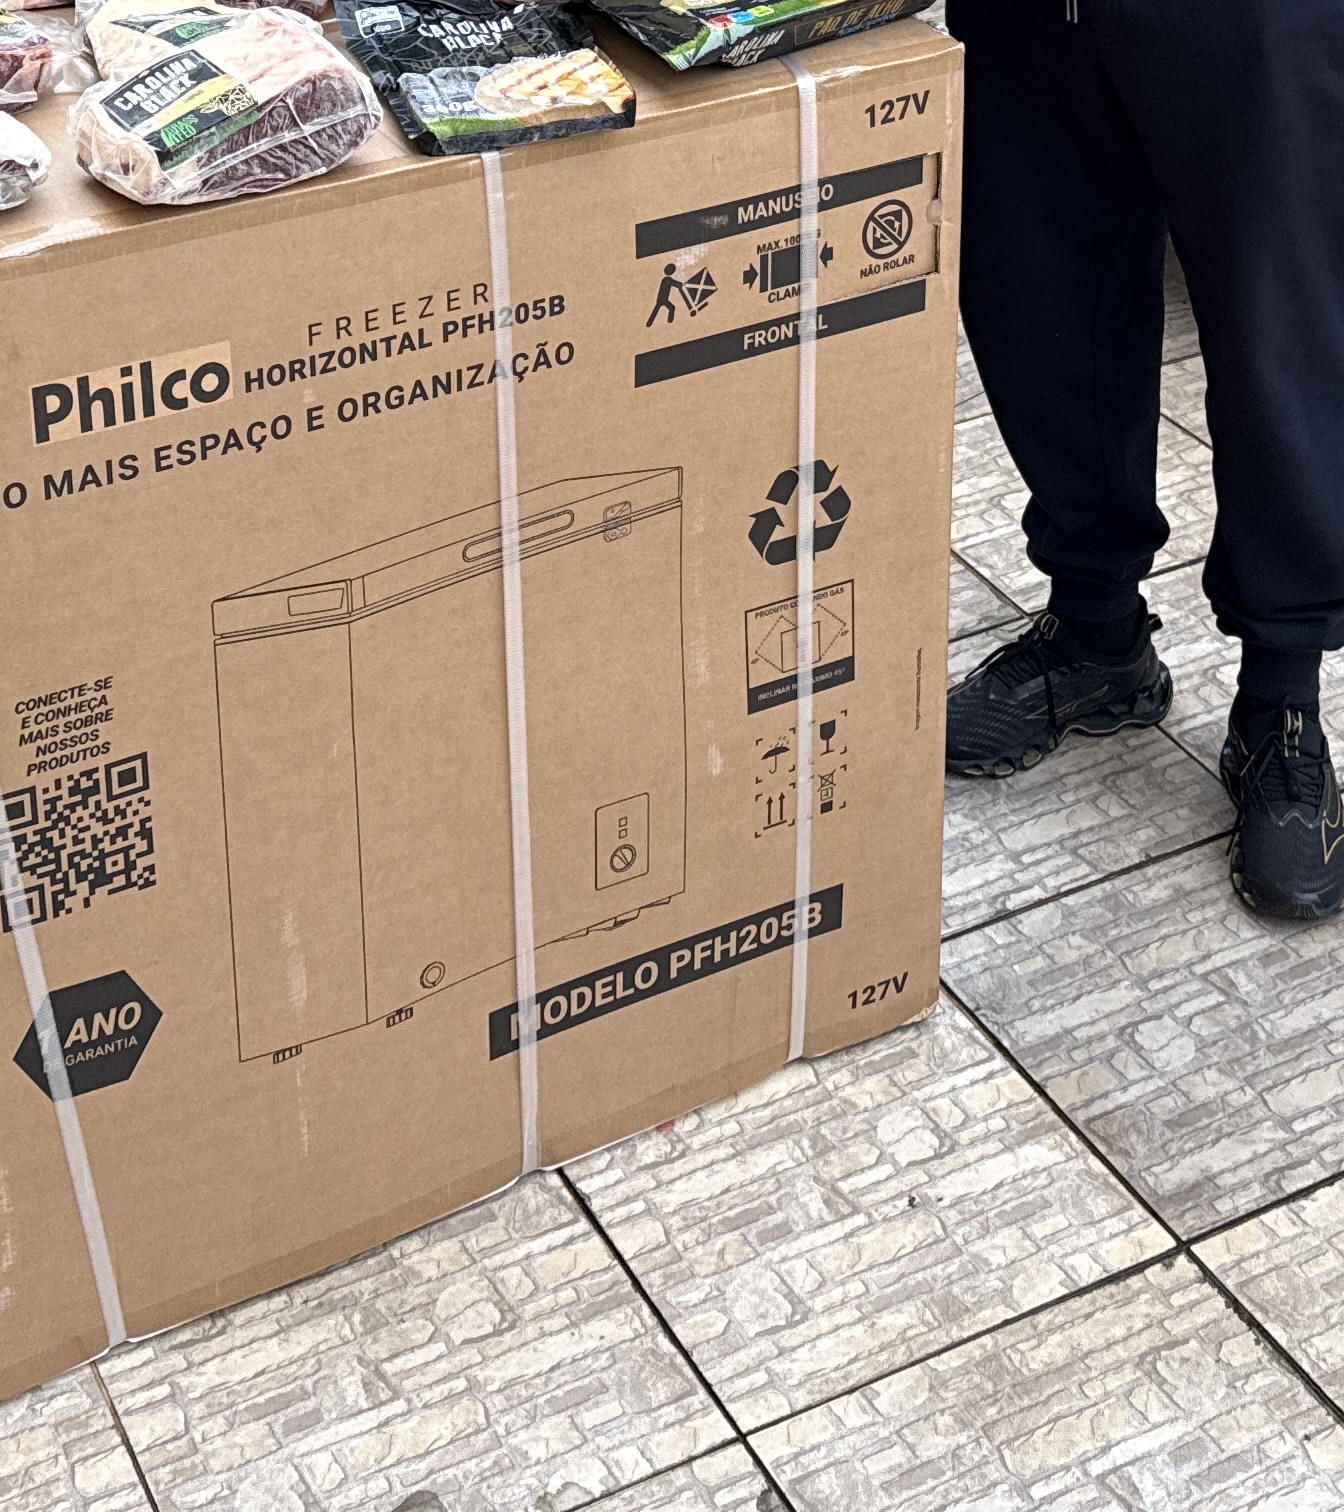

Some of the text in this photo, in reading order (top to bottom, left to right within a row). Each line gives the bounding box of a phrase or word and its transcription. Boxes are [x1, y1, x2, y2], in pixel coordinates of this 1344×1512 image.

[416, 15, 515, 39] CAROLINA
[440, 32, 504, 52] BLACK
[113, 57, 198, 111] CAROLINA
[139, 73, 198, 115] BLACK
[863, 89, 931, 128] 127V
[737, 183, 834, 225] MANUSIO
[859, 253, 915, 279] NÃO ROLAR
[767, 283, 806, 304] CLAM
[307, 282, 490, 347] FREEZER
[743, 313, 829, 351] FRONTL
[33, 294, 566, 445] Philco HORIZONTAL PFH205B
[42, 454, 140, 502] MAIS
[153, 414, 294, 474] ESPAÇO
[306, 406, 327, 433] E
[336, 340, 577, 423] ORGANIZAÇÃO
[14, 675, 114, 715] CONECTE-SE
[20, 694, 109, 730] E CONHEÇA
[18, 707, 115, 748] MAIS SOBRE
[35, 728, 101, 759] NOSSOS
[26, 741, 112, 778] PRODUTOS
[669, 901, 823, 980] PFH205B
[846, 971, 909, 1010] 127V
[63, 1000, 142, 1050] ANO
[65, 1035, 139, 1067] GARANTIA
